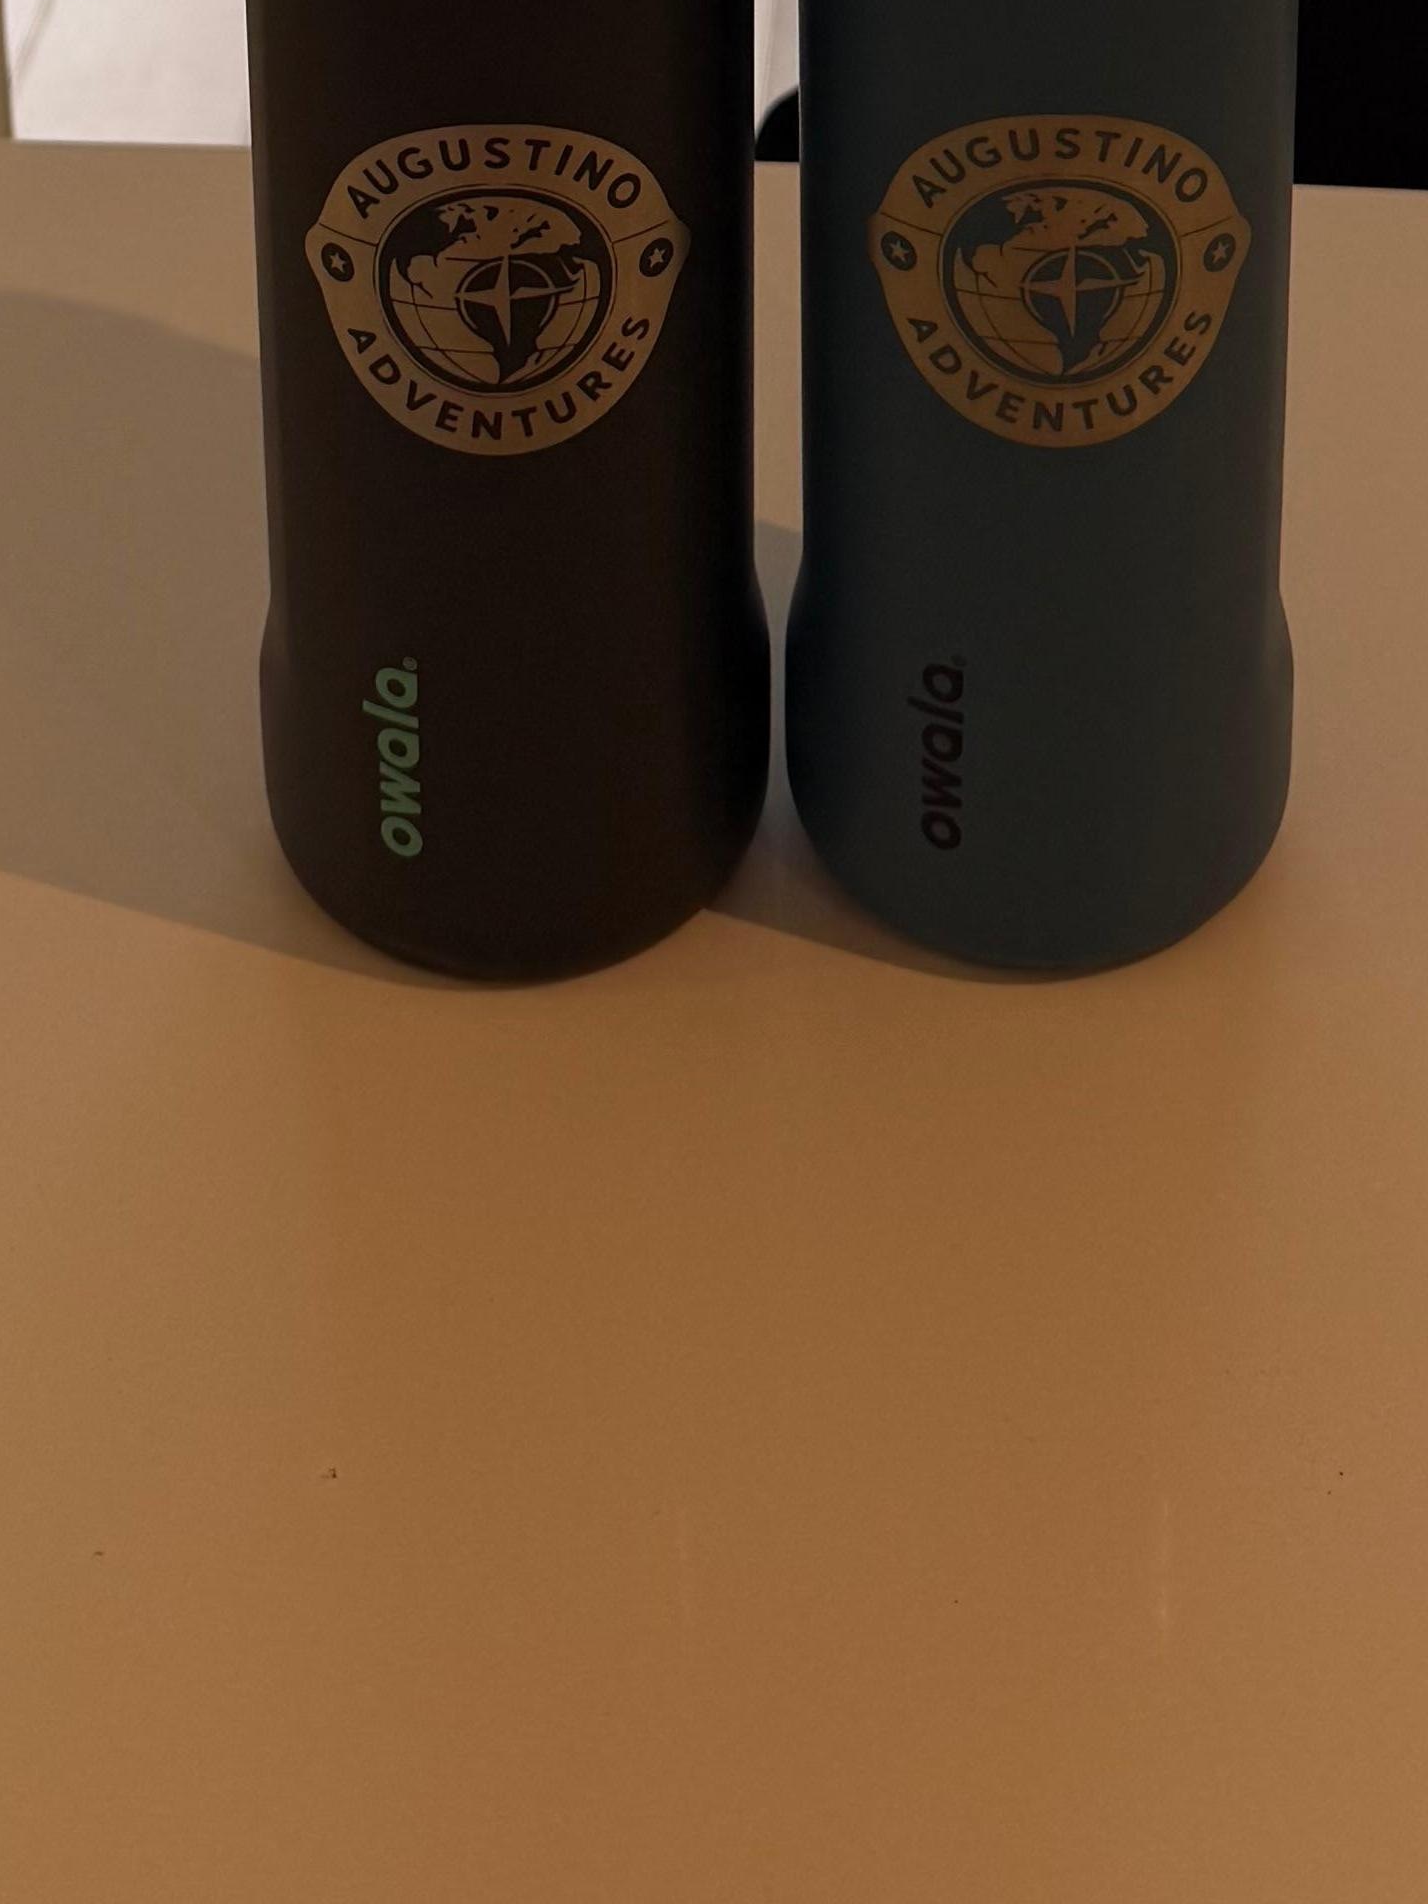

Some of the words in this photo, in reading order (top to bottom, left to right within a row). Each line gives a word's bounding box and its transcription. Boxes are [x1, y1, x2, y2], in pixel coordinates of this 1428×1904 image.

[346, 137, 641, 219] AUGUSTINO
[910, 128, 1208, 208] AUGUSTINO
[346, 317, 651, 440] ADVENTURES
[907, 309, 1211, 433] ADVENTURES
